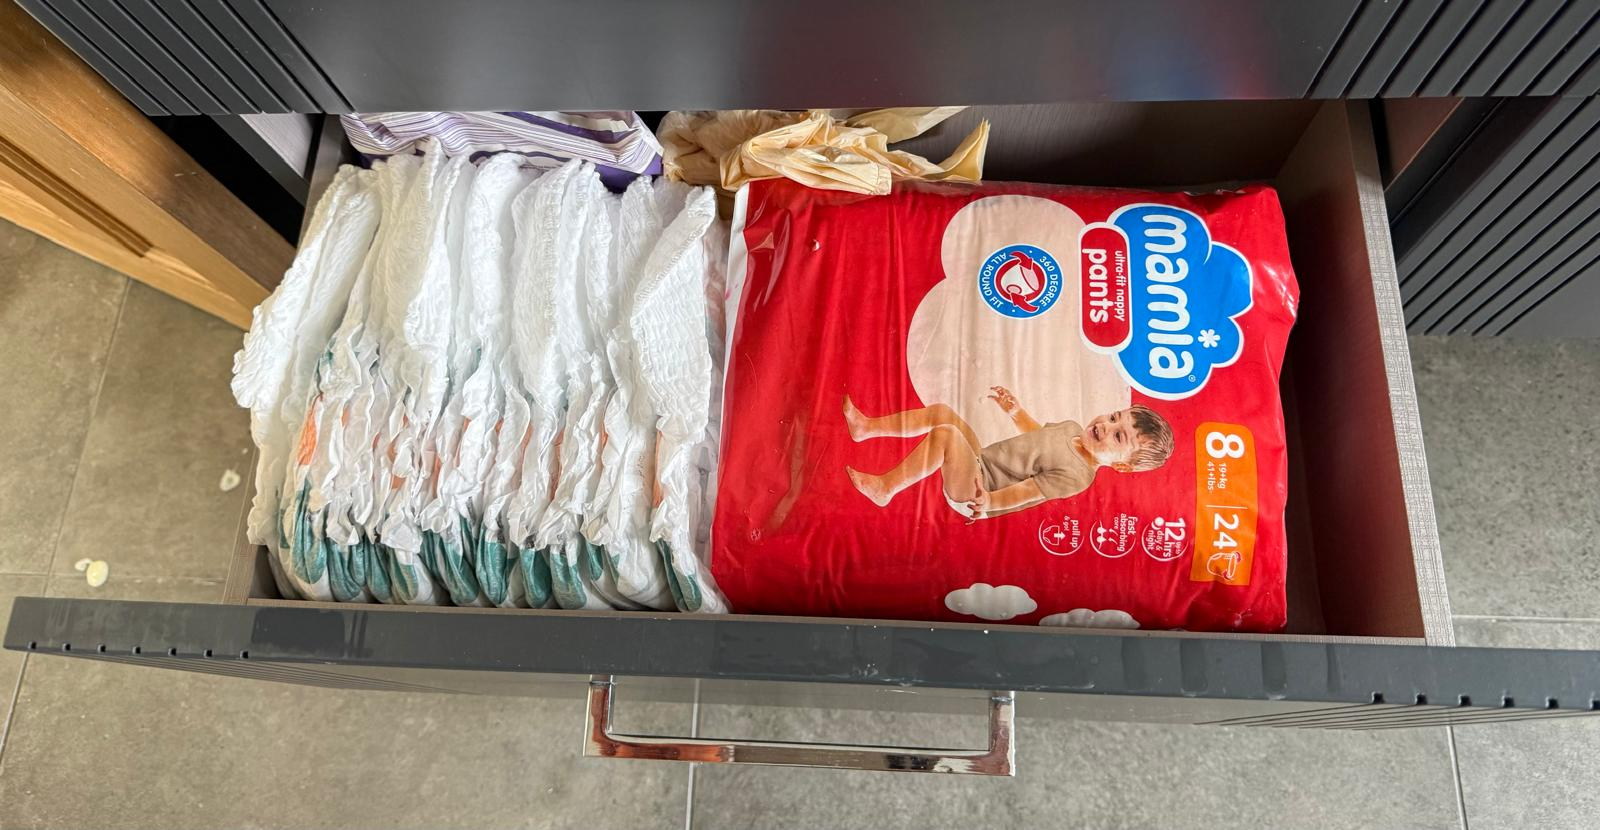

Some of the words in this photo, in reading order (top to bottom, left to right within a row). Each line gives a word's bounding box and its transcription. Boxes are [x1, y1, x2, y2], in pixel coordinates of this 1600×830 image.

[991, 252, 1007, 265] ALL
[1040, 256, 1055, 272] 360
[1114, 250, 1127, 286] ultra-fit
[981, 264, 995, 297] ROUND
[1040, 274, 1059, 307] DEGREE
[1081, 248, 1114, 323] pants
[990, 296, 1004, 309] FIT
[1114, 288, 1126, 322] nappy
[1142, 214, 1195, 379] mamia
[1205, 431, 1245, 459] 8
[1217, 462, 1229, 490] 19+kg
[1070, 519, 1081, 536] pull
[1117, 513, 1128, 552] absorbing
[1146, 530, 1156, 550] night
[1155, 530, 1164, 545] day
[1165, 517, 1186, 541] 12
[1213, 512, 1240, 550] 24
[1070, 537, 1078, 548] up
[1163, 541, 1176, 558] hrs
